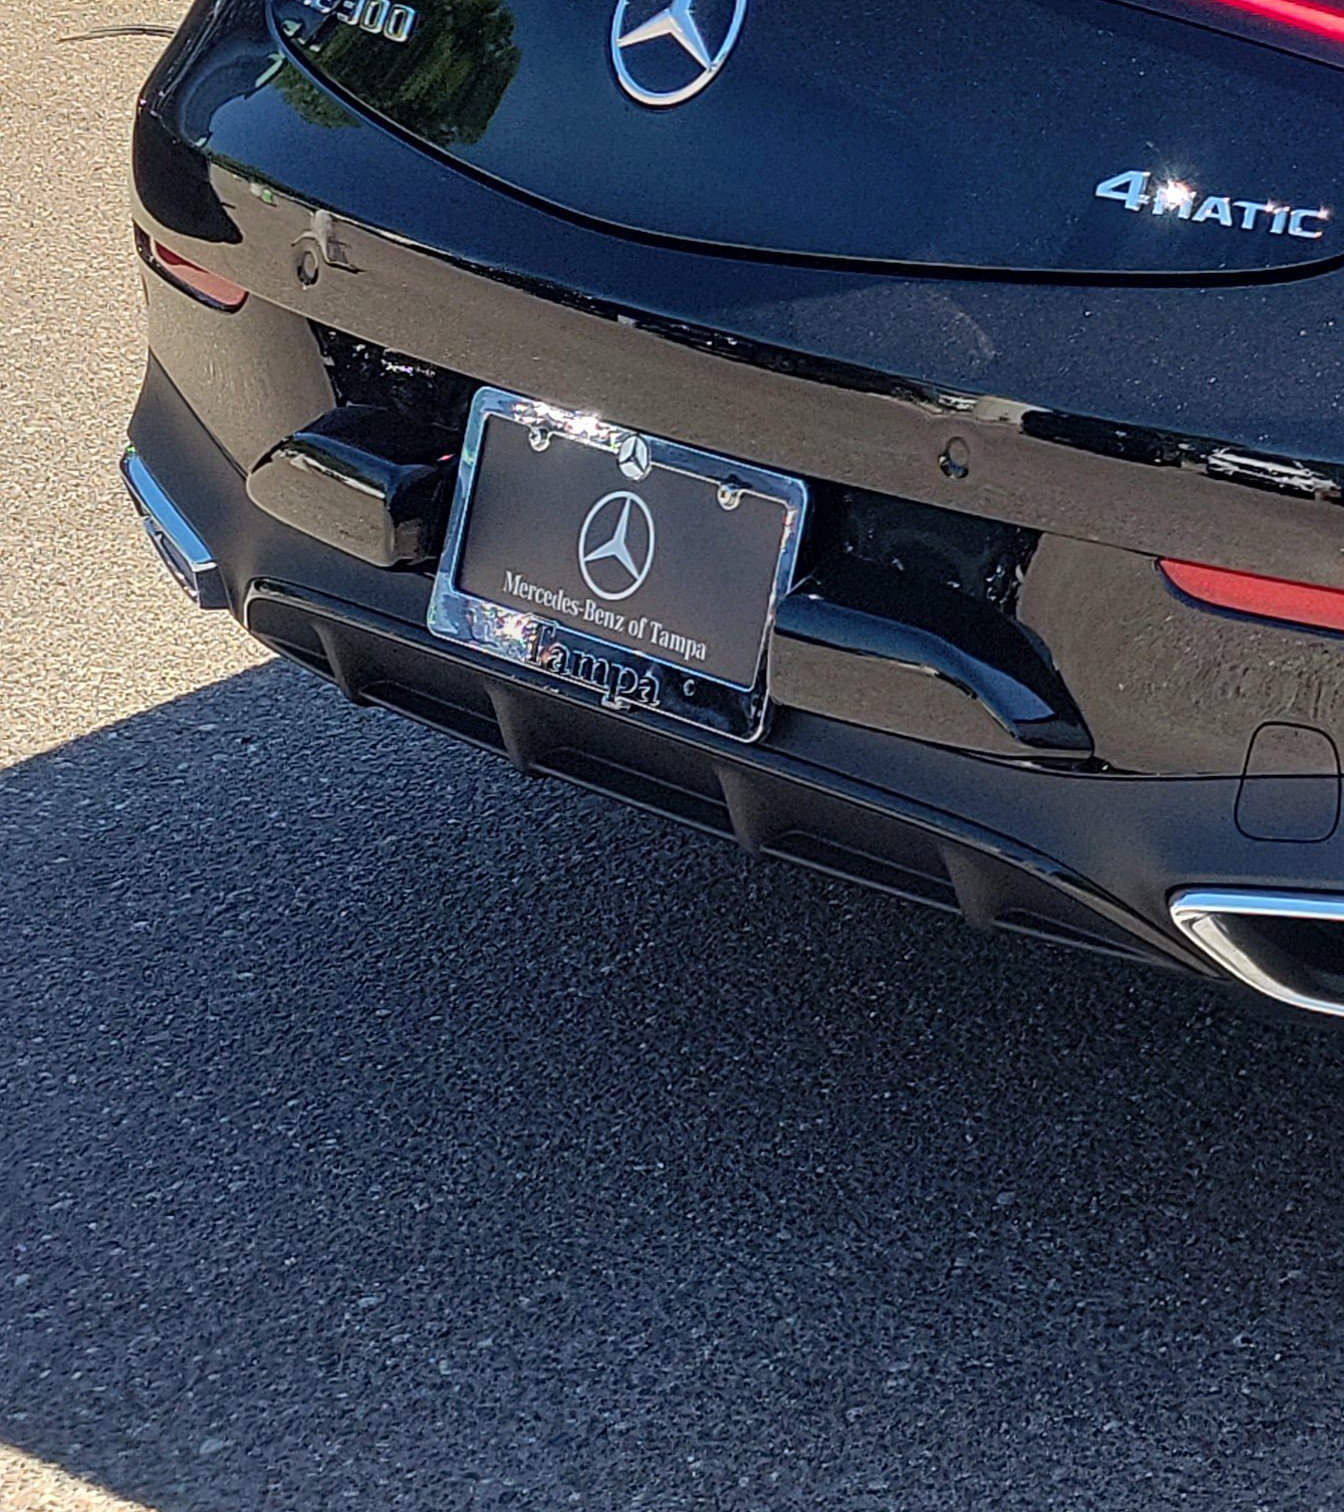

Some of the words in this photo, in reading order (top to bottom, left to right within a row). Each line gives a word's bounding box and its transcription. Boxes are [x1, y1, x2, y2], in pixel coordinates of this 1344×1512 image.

[1094, 169, 1331, 239] 4MATIC
[502, 570, 626, 633] Mercedes-Benz
[627, 615, 648, 641] of
[648, 621, 708, 662] Tampa
[525, 619, 662, 712] Tampa
